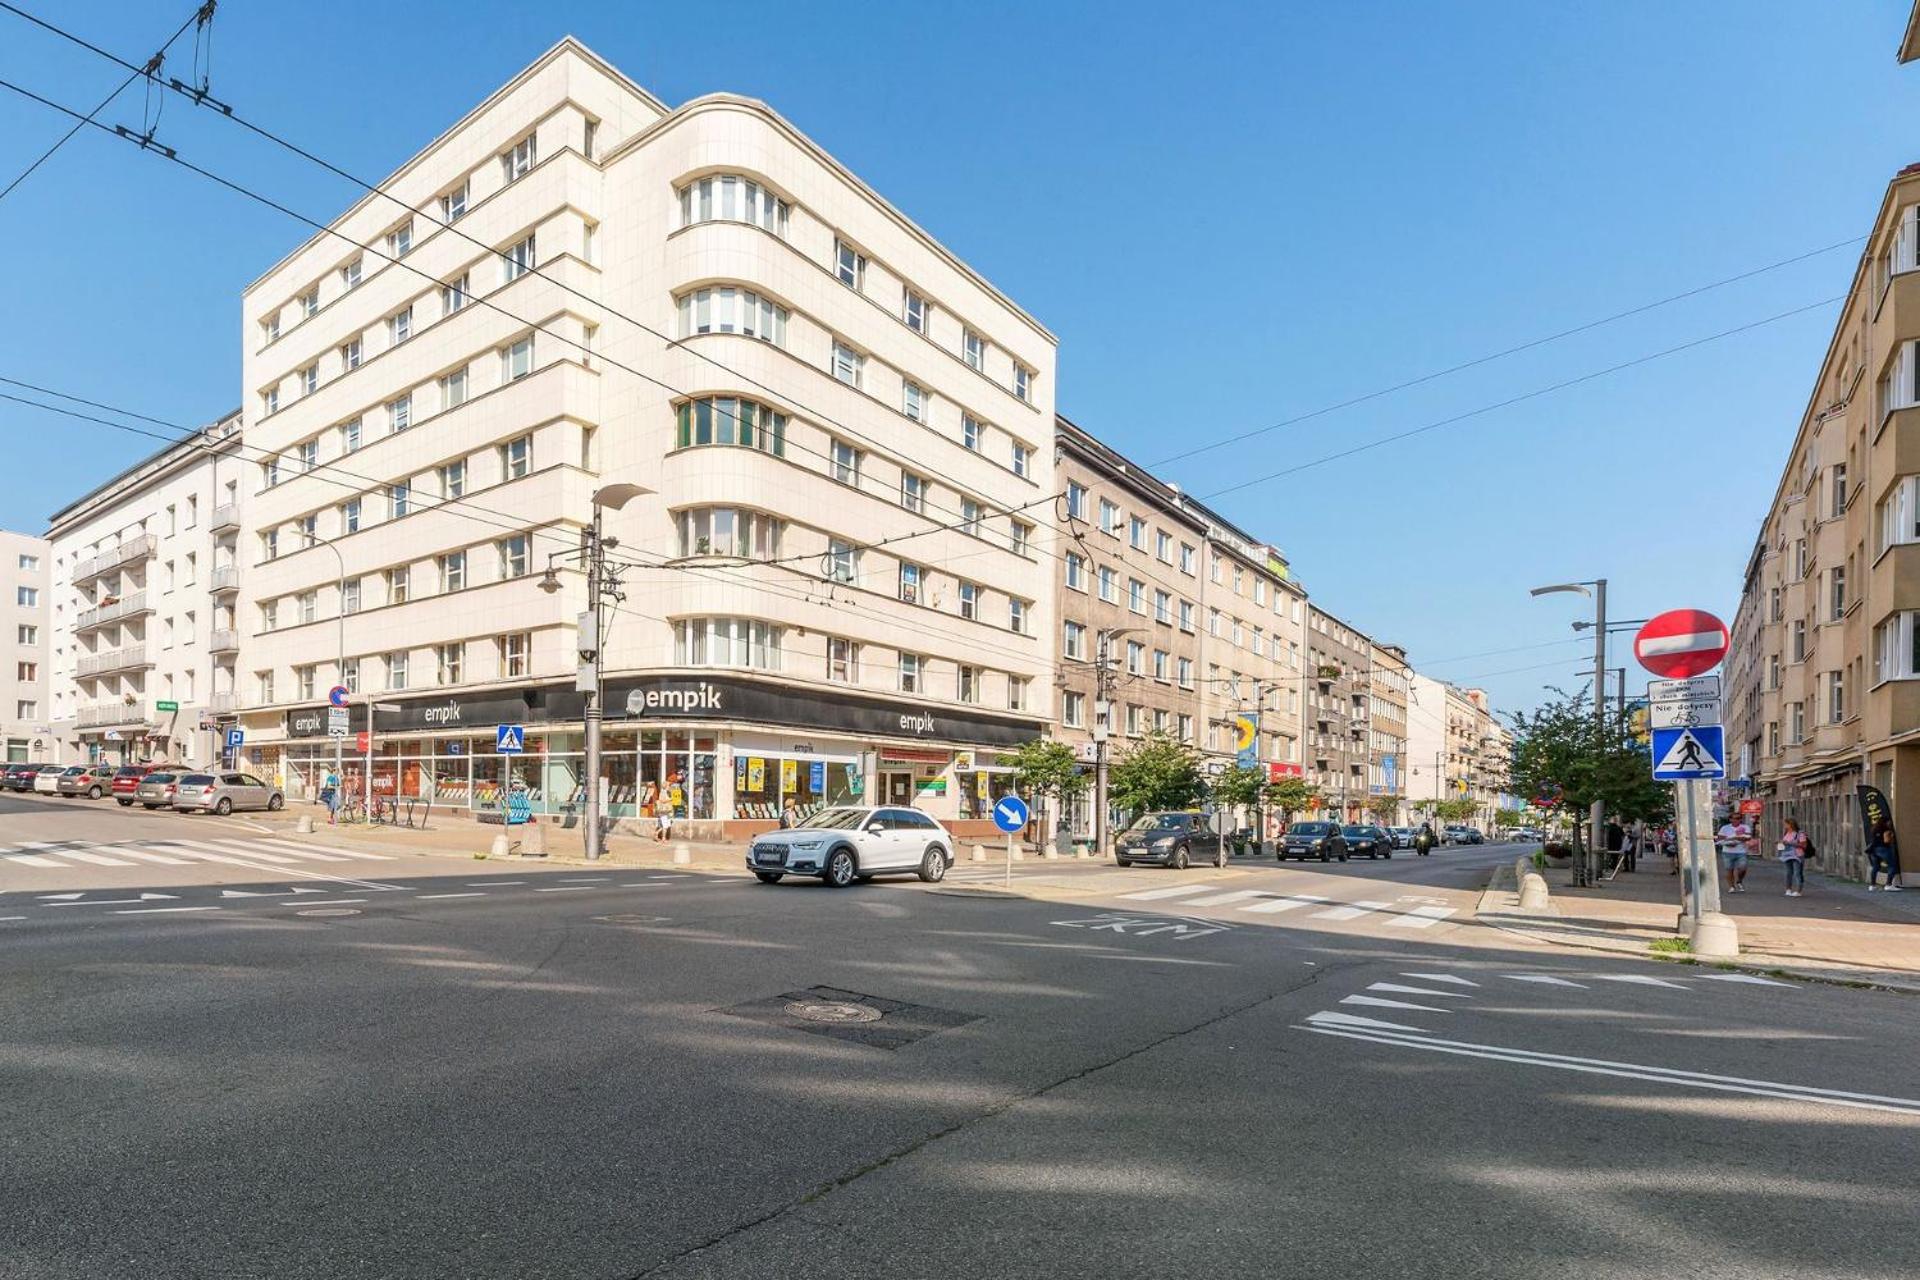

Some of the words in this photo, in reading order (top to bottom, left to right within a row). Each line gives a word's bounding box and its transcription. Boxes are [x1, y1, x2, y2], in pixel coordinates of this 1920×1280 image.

[646, 682, 721, 712] empik
[1677, 702, 1714, 711] dotyczy
[425, 699, 461, 724] empik
[295, 712, 321, 733] empik
[900, 711, 935, 734] empik
[231, 732, 240, 744] P
[794, 742, 814, 754] empik
[372, 773, 394, 790] empik
